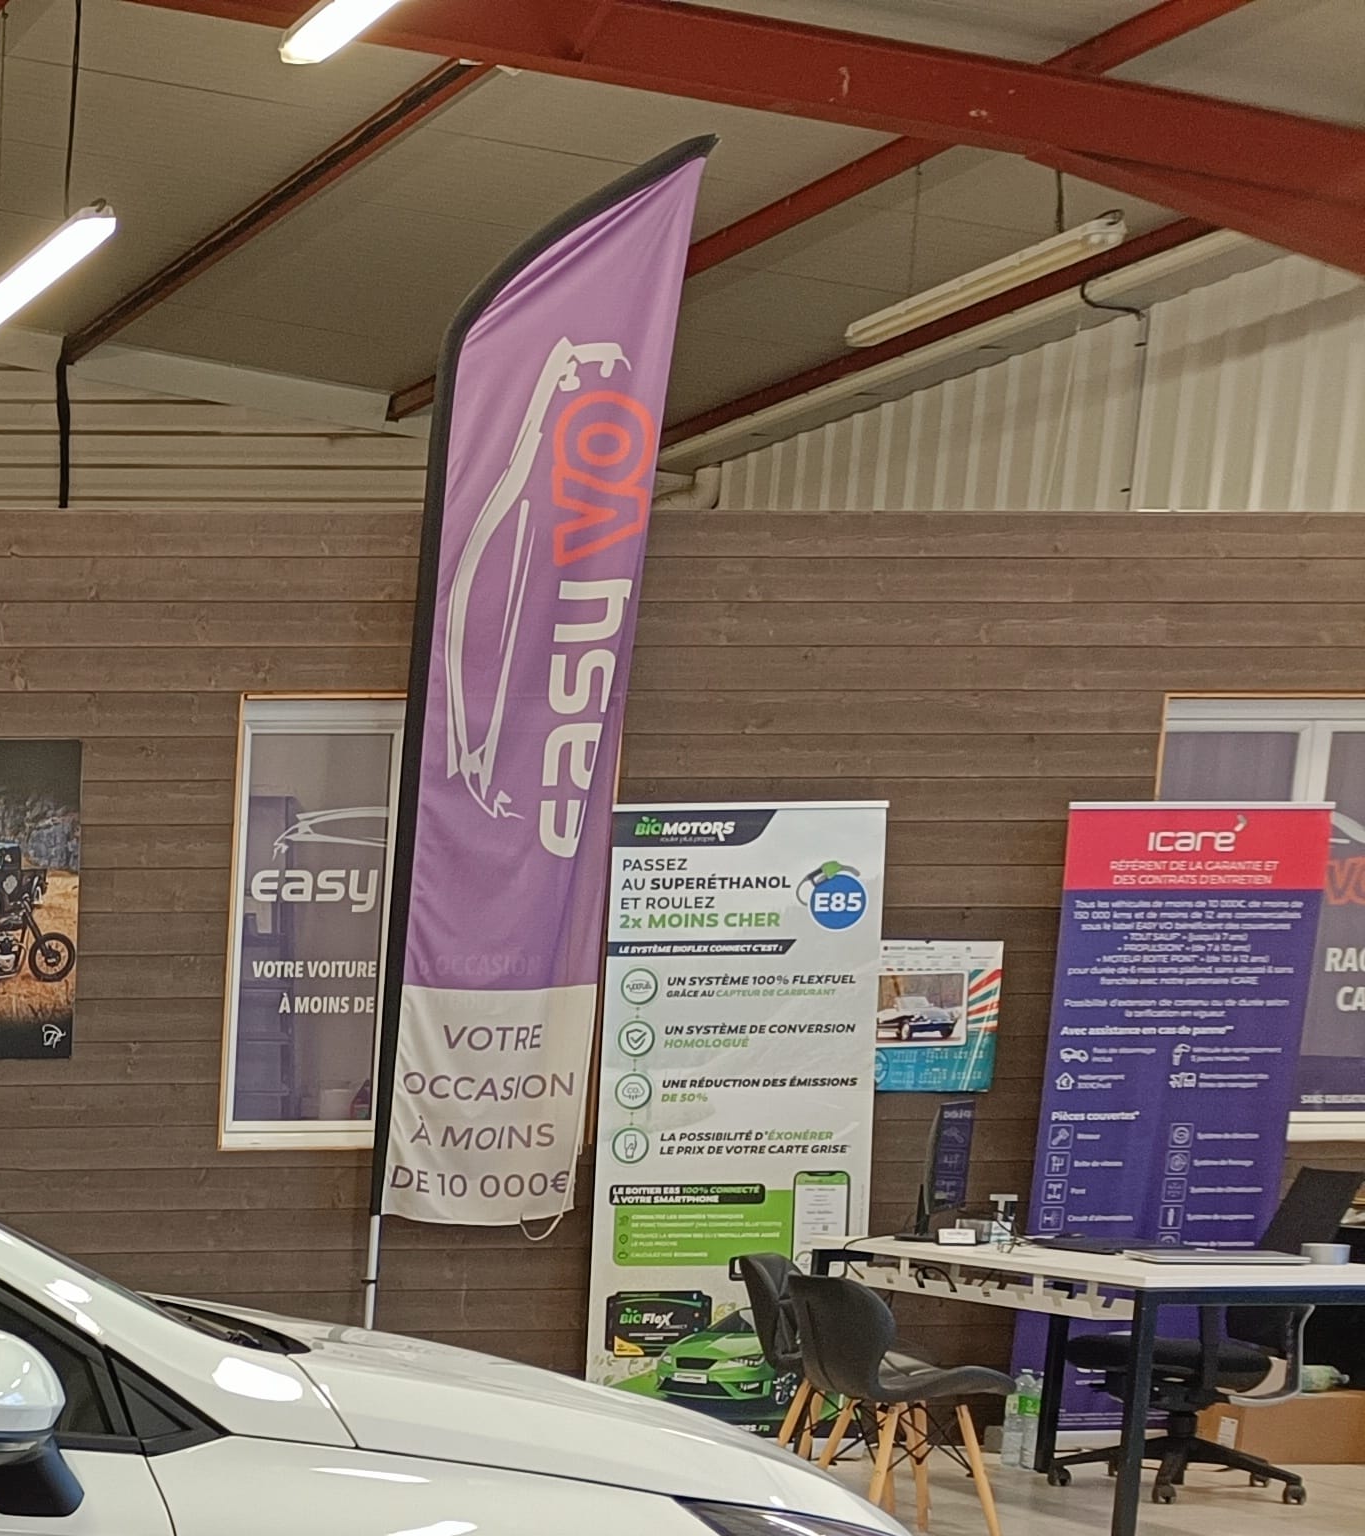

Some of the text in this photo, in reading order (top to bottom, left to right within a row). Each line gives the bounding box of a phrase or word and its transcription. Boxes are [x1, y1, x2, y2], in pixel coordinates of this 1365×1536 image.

[539, 389, 656, 858] easy VO
[622, 858, 688, 871] PASSEZ
[1170, 861, 1187, 871] DE
[1188, 861, 1203, 871] LA
[621, 874, 791, 890] AU SUPERÉTHANOL
[1113, 874, 1136, 885] DES
[251, 869, 379, 913] easy
[620, 897, 715, 910] ET ROULEZ
[814, 892, 862, 912] E85
[619, 912, 780, 929] 2x MOINS CHER
[619, 946, 629, 954] LE
[252, 960, 377, 978] VOTRE VOITURE
[667, 973, 856, 986] UN SYSTÈME 100% FLEXFUEL
[666, 987, 837, 998] GRÂCE AU CAPTEUR DE CARBURANT
[278, 992, 375, 1014] À MOINS DE
[664, 1022, 856, 1036] UN SYSTÈME DE CONVERSION
[443, 1024, 543, 1051] VOTRE
[663, 1036, 750, 1049] HOMOLOGUÉ
[403, 1071, 574, 1102] OCCASION
[662, 1075, 858, 1089] UNE RÉDUCTION DES ÉMISSIONS
[661, 1092, 708, 1103] DE 50%
[410, 1115, 555, 1150] À MOINS
[660, 1132, 676, 1141] LA
[679, 1130, 753, 1141] POSSIBILITÉ
[659, 1146, 675, 1155] LE
[676, 1146, 705, 1155] PRIX
[707, 1146, 723, 1155] DE
[724, 1145, 766, 1154] VOTRE
[768, 1145, 809, 1154] CARTE
[390, 1165, 571, 1198] DE 10 000€
[612, 1187, 624, 1195] LE
